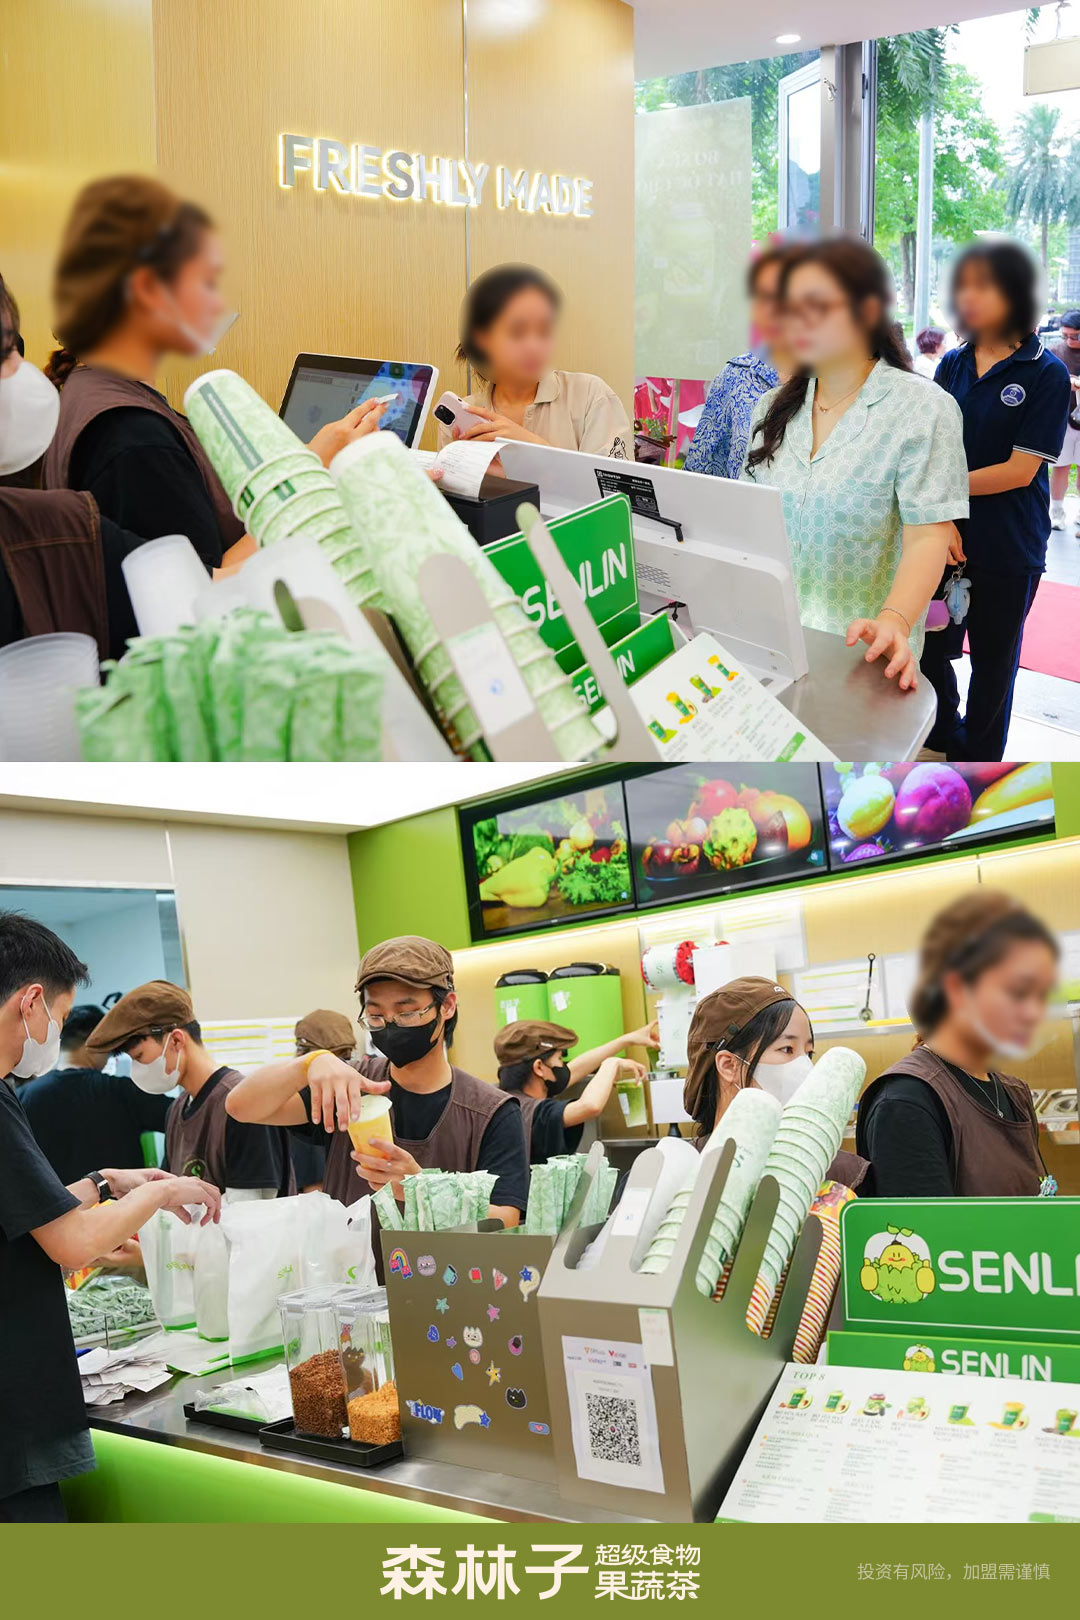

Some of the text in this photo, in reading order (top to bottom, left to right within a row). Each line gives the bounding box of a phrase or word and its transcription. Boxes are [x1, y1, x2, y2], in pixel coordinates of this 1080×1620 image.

[280, 133, 594, 217] FRESHLY MADE
[793, 1371, 817, 1381] TOP
[941, 1349, 1052, 1383] SENLIN
